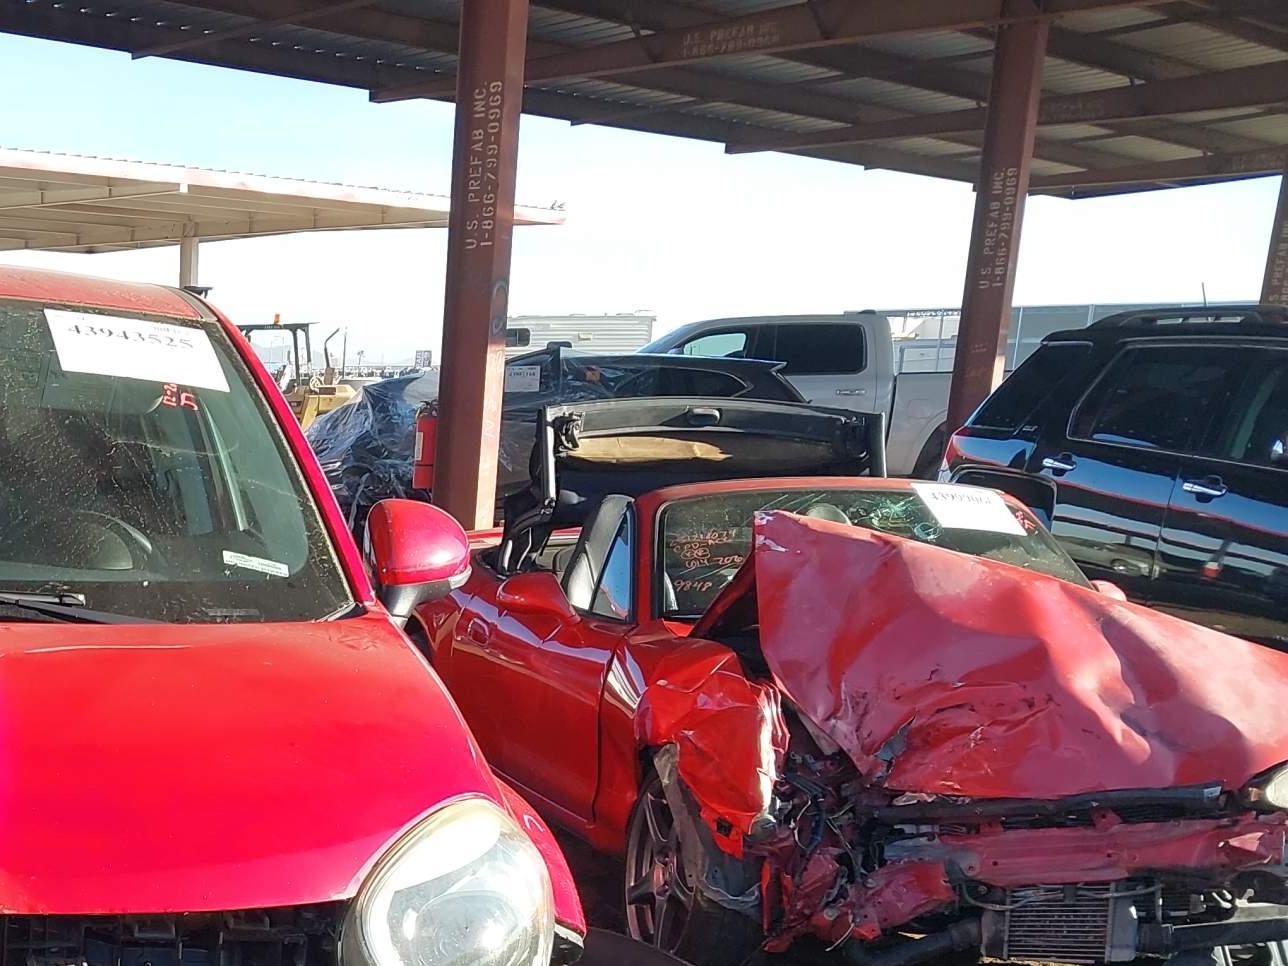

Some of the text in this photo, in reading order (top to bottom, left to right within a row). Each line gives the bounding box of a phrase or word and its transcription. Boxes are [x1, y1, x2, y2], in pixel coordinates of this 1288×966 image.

[468, 128, 484, 203] PREFAB
[480, 80, 503, 247] 1-866-799-0969
[984, 201, 1001, 255] PREFAB
[68, 323, 195, 350] 43943525
